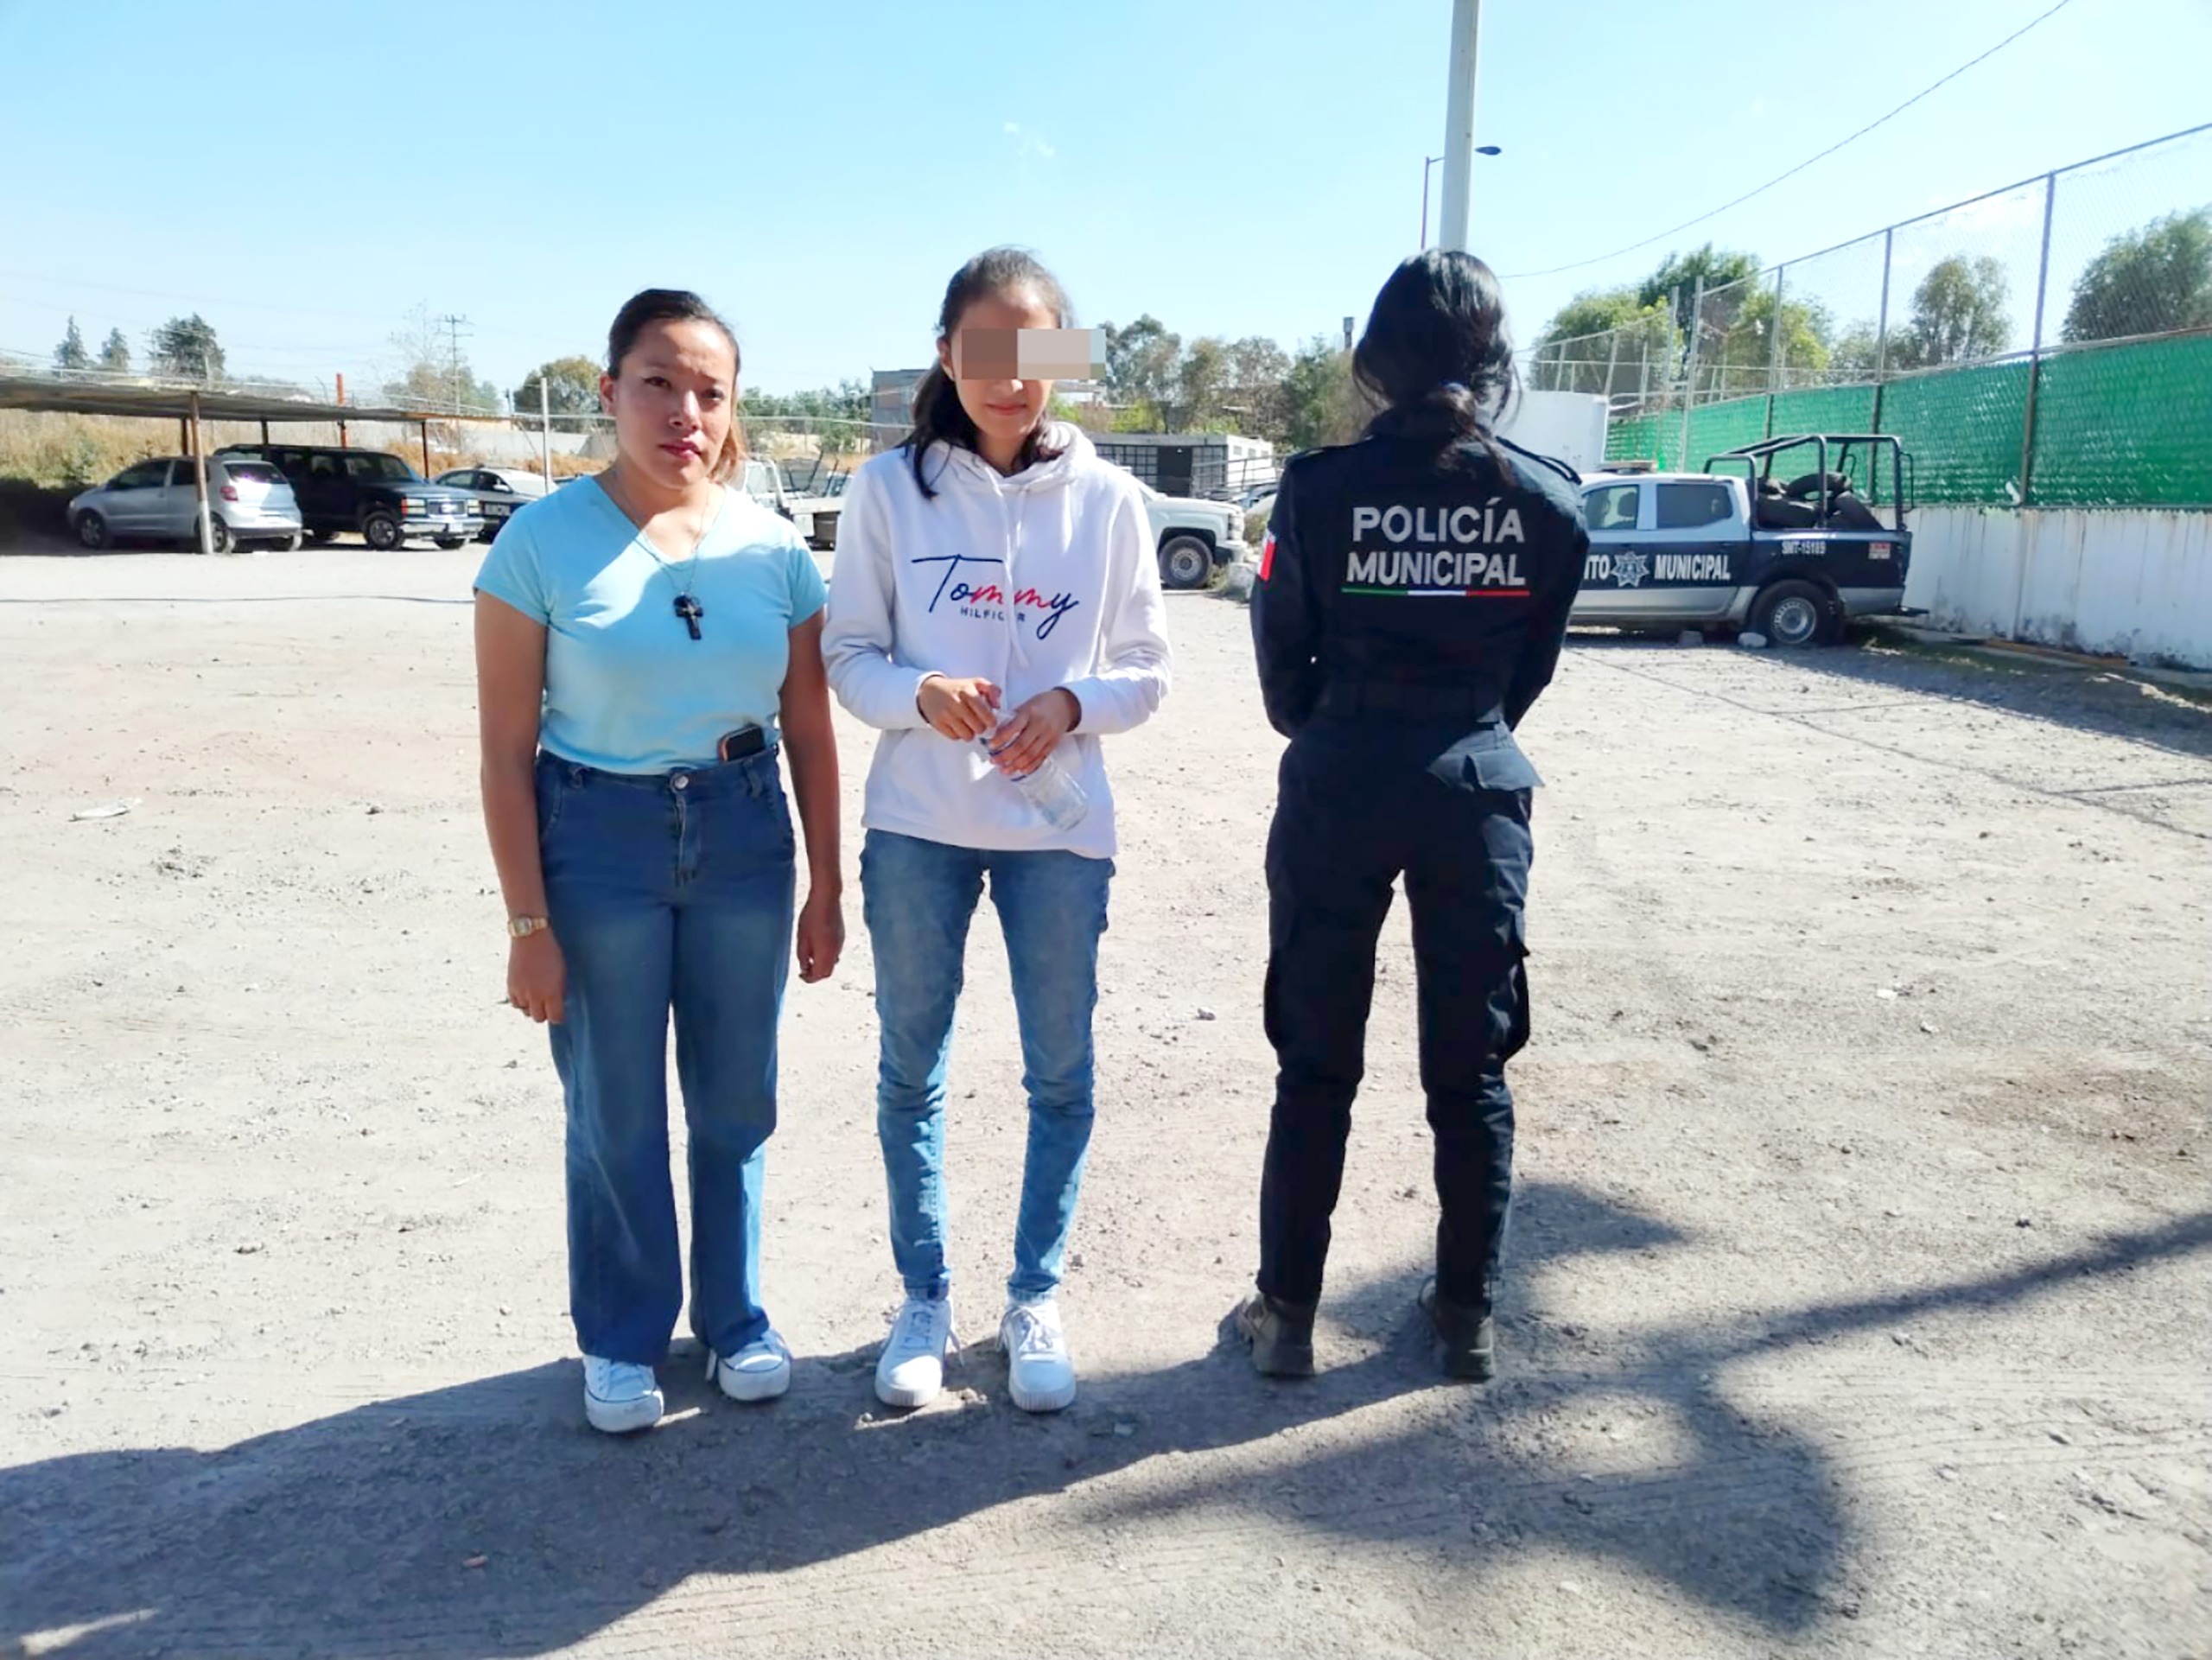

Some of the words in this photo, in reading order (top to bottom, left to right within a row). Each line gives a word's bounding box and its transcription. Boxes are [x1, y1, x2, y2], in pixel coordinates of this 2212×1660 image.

[1352, 497, 1525, 544] POLICÍA
[1346, 550, 1526, 587] MUNICIPAL
[1654, 554, 1731, 580] MUNICIPAL
[912, 553, 1079, 640] Tommy
